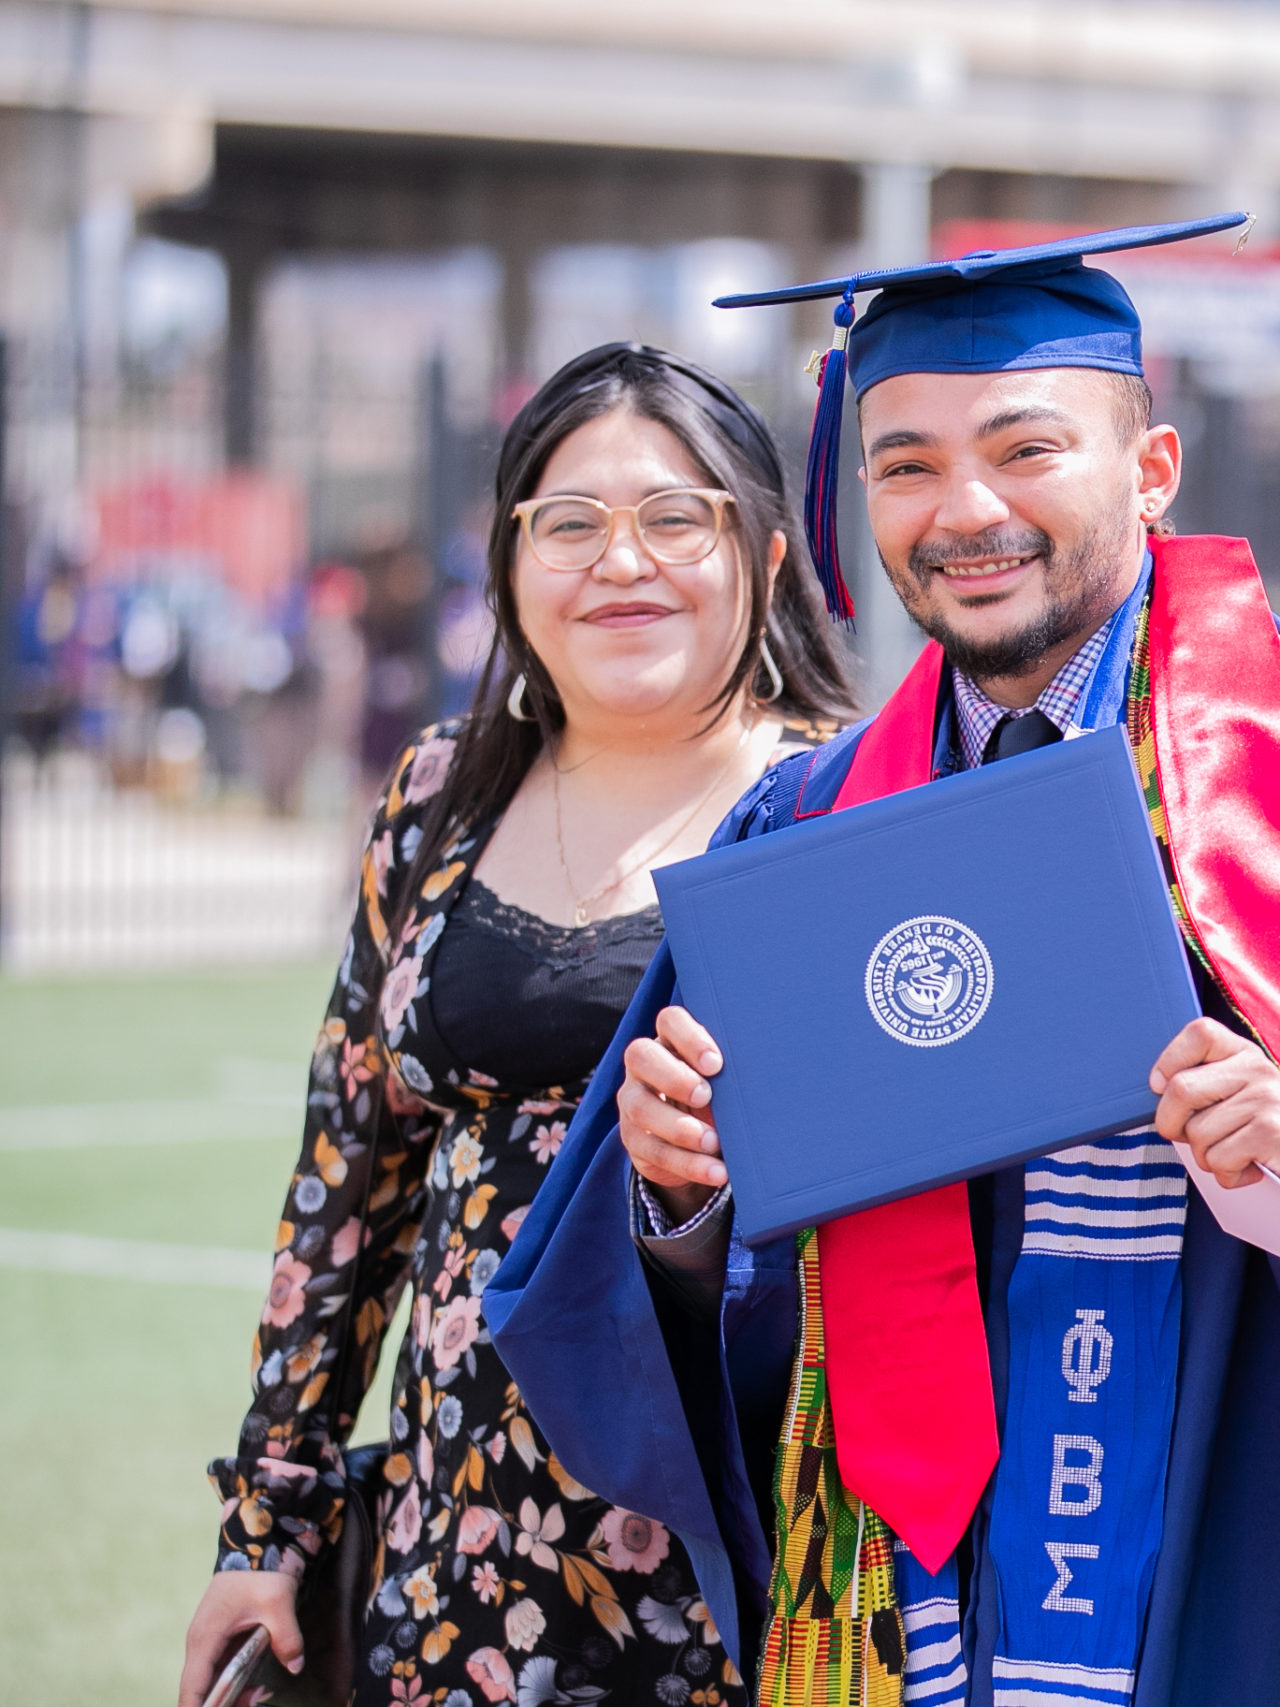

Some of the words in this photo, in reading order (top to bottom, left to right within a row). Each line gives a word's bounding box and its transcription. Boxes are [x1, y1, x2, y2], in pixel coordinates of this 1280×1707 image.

[882, 924, 931, 956] DENVER
[936, 925, 954, 936] OF
[900, 955, 927, 971] 1965
[953, 935, 985, 1029] METROPOLITAN
[873, 960, 909, 1034] UNIVERSITY
[911, 1027, 951, 1039] STATE
